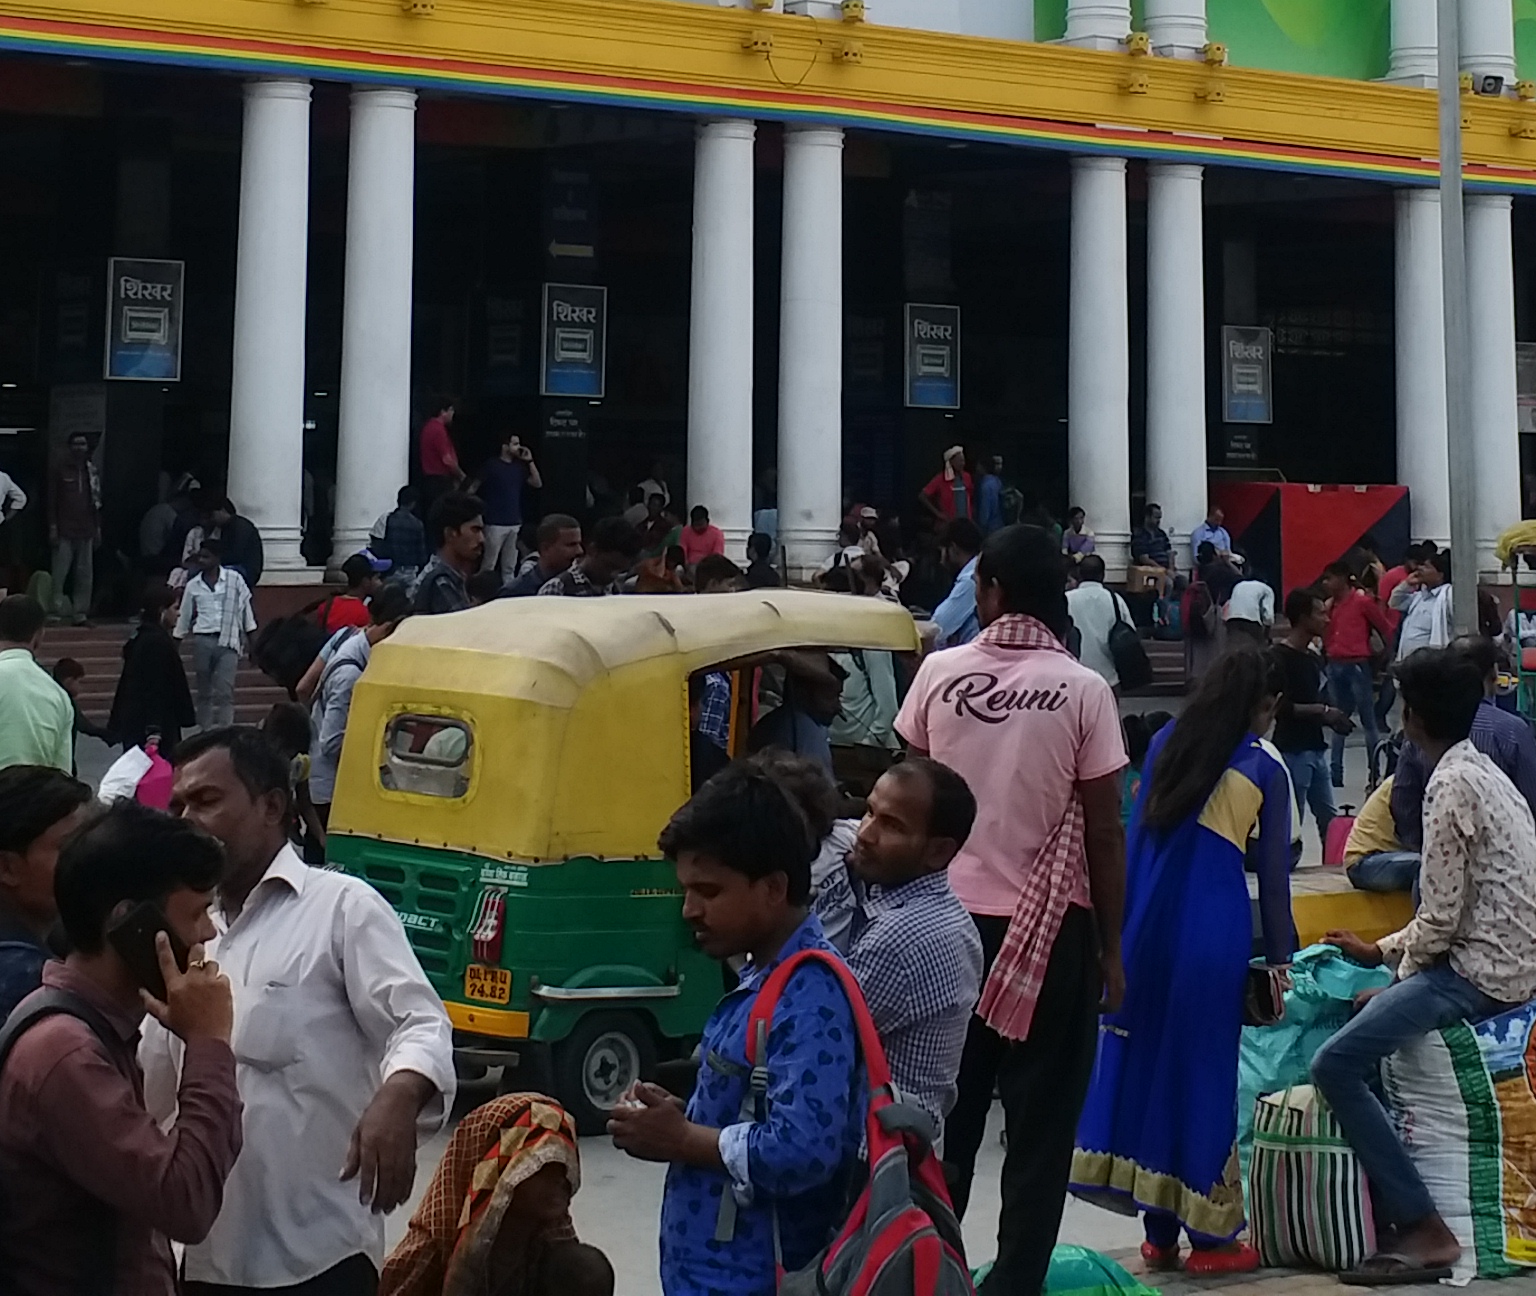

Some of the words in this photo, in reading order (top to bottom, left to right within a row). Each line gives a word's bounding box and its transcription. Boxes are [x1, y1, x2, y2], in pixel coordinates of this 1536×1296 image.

[119, 275, 173, 301] शिखर
[552, 300, 596, 323] शिखर
[942, 672, 1068, 724] Reuni
